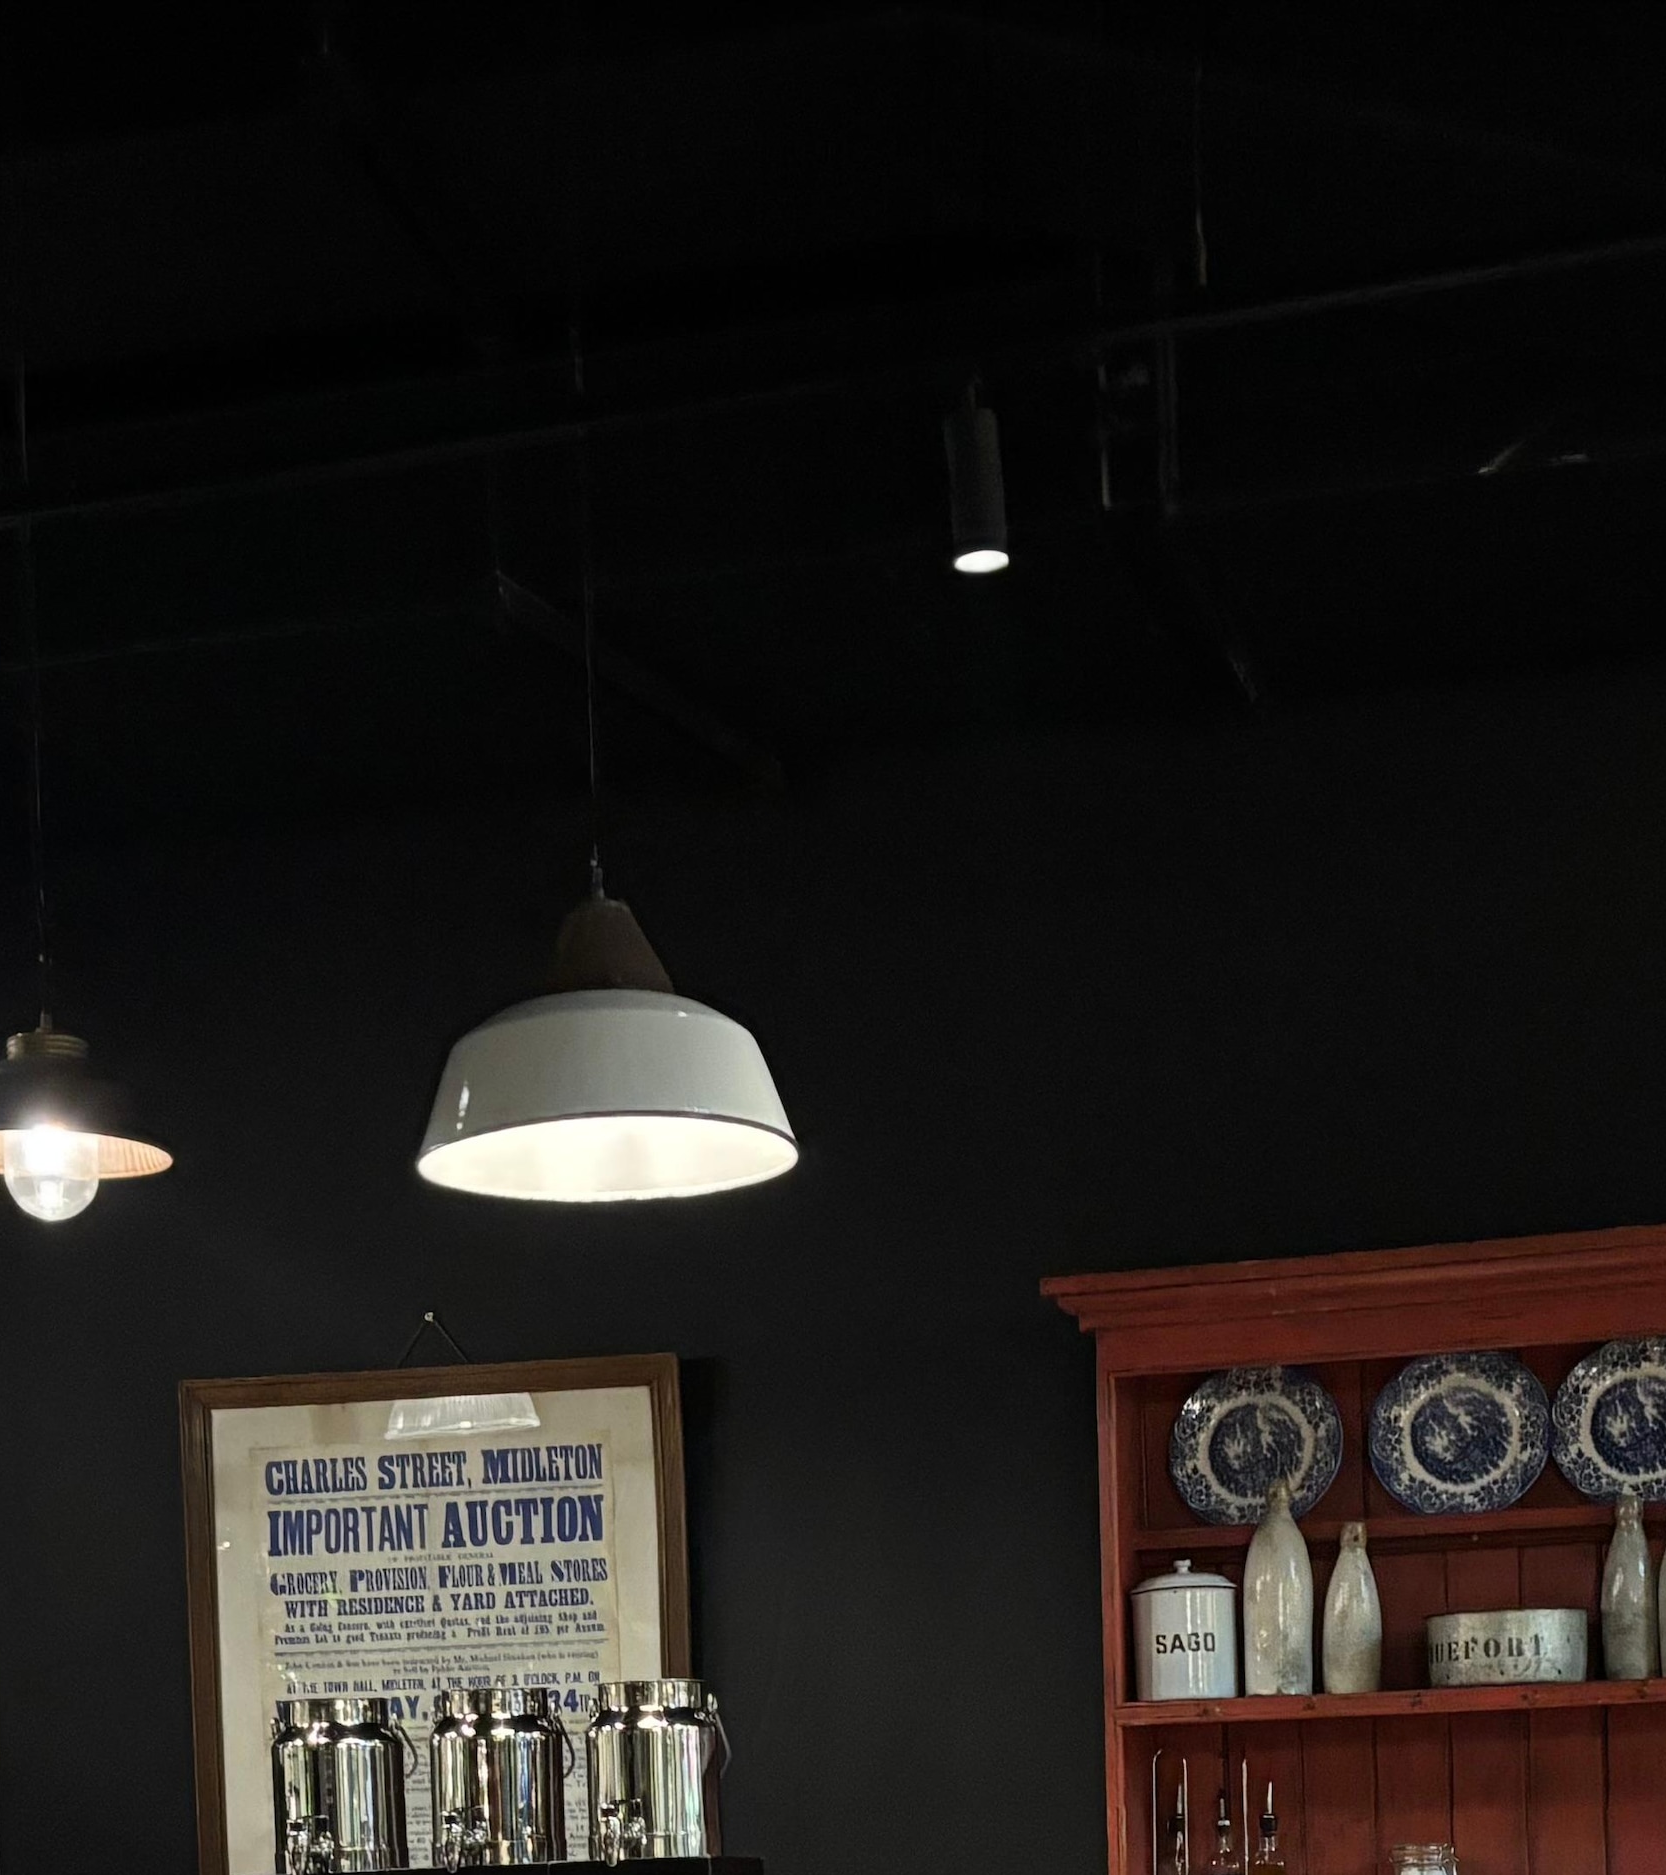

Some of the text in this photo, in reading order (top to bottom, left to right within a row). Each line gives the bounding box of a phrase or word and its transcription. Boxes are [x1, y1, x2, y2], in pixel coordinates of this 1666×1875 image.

[265, 1443, 603, 1496] CHARLES STREET, MIDLETON
[267, 1494, 604, 1557] IMPORTANT AUCTION
[438, 1563, 484, 1589] FLOUR
[487, 1562, 495, 1587] &
[498, 1560, 544, 1587] MEAL
[550, 1557, 609, 1583] STORES
[284, 1587, 594, 1619] WITH RESIDENCE & YARD ATTACHED.
[376, 1619, 396, 1630] with
[496, 1613, 510, 1625] the
[583, 1609, 598, 1621] and
[345, 1632, 365, 1645] good
[1155, 1632, 1216, 1654] SAGO
[323, 1680, 349, 1694] TOWN
[446, 1676, 463, 1689] THE
